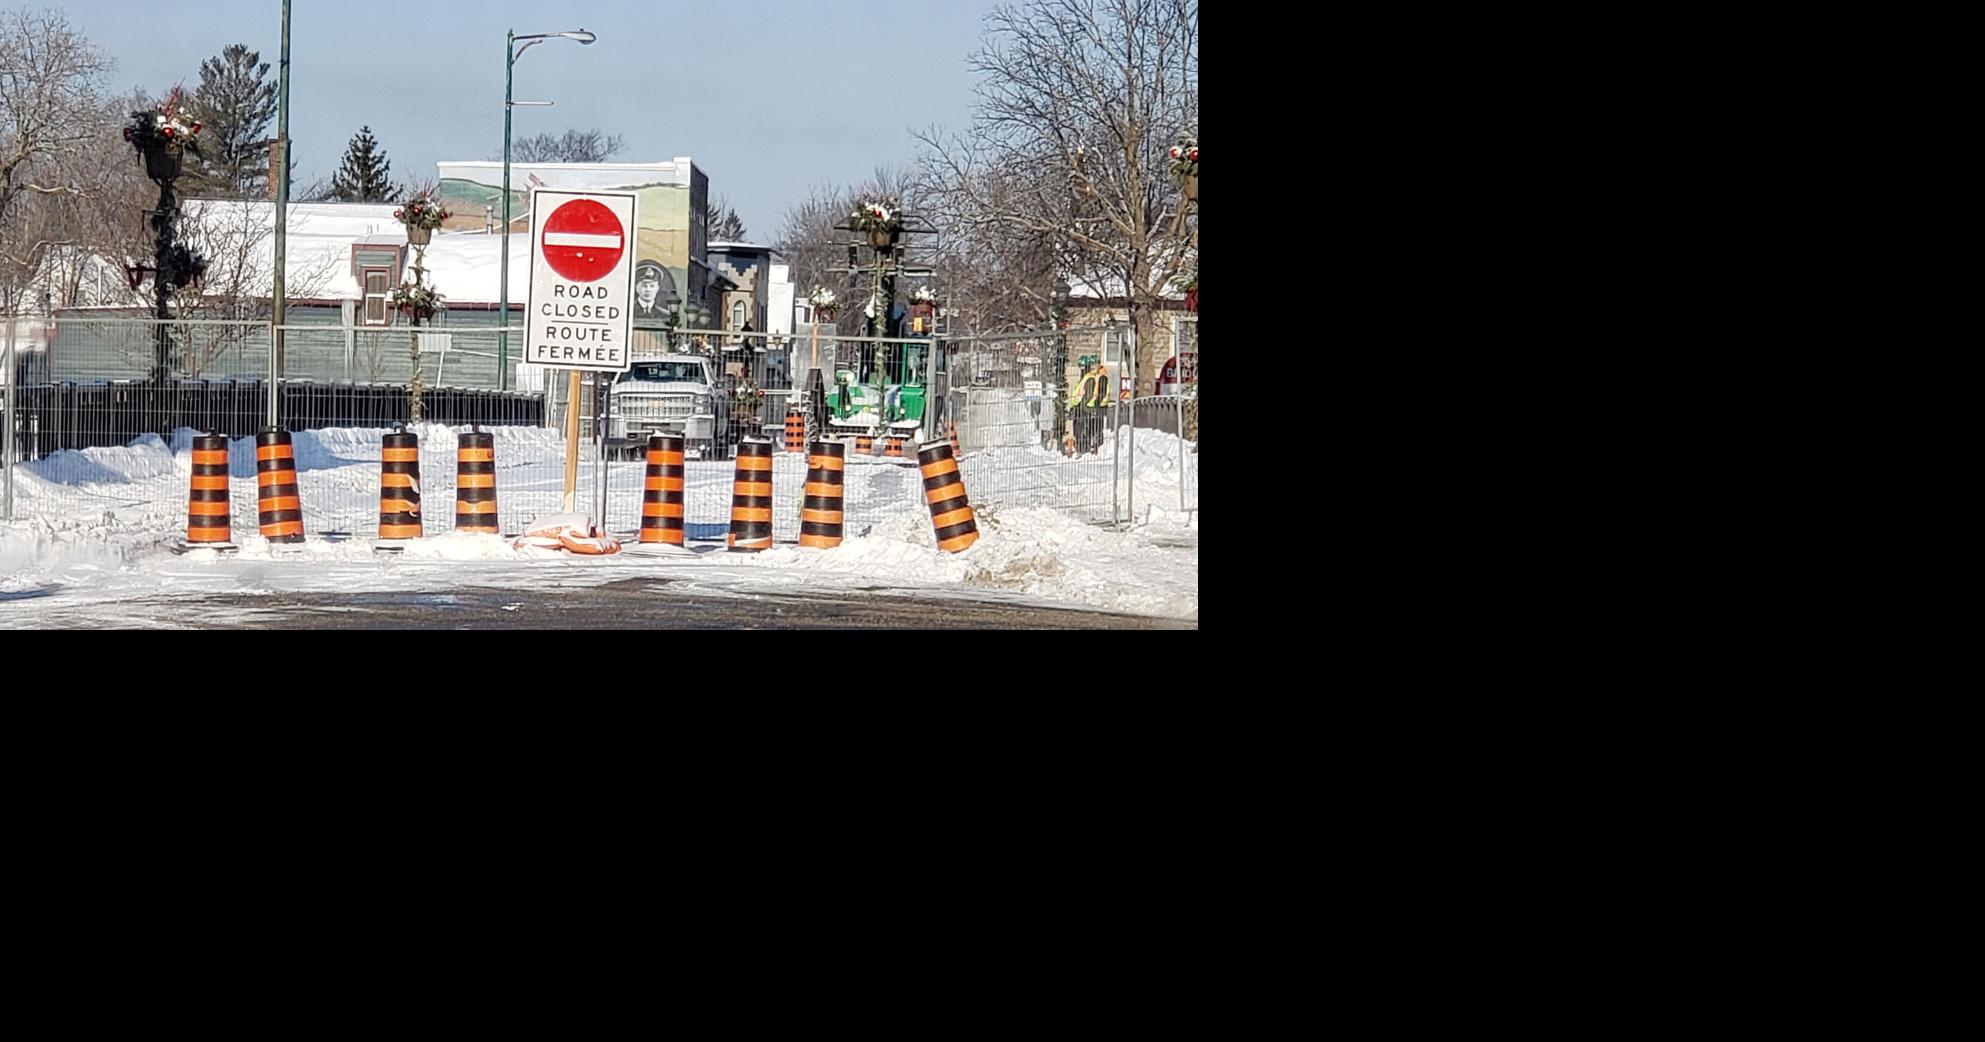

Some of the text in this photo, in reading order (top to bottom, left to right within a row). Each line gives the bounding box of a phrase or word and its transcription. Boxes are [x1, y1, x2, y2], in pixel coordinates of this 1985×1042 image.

[554, 284, 608, 299] ROAD
[541, 303, 620, 319] CLOSED
[546, 326, 611, 342] ROUTE
[538, 344, 619, 362] FERMÉE
